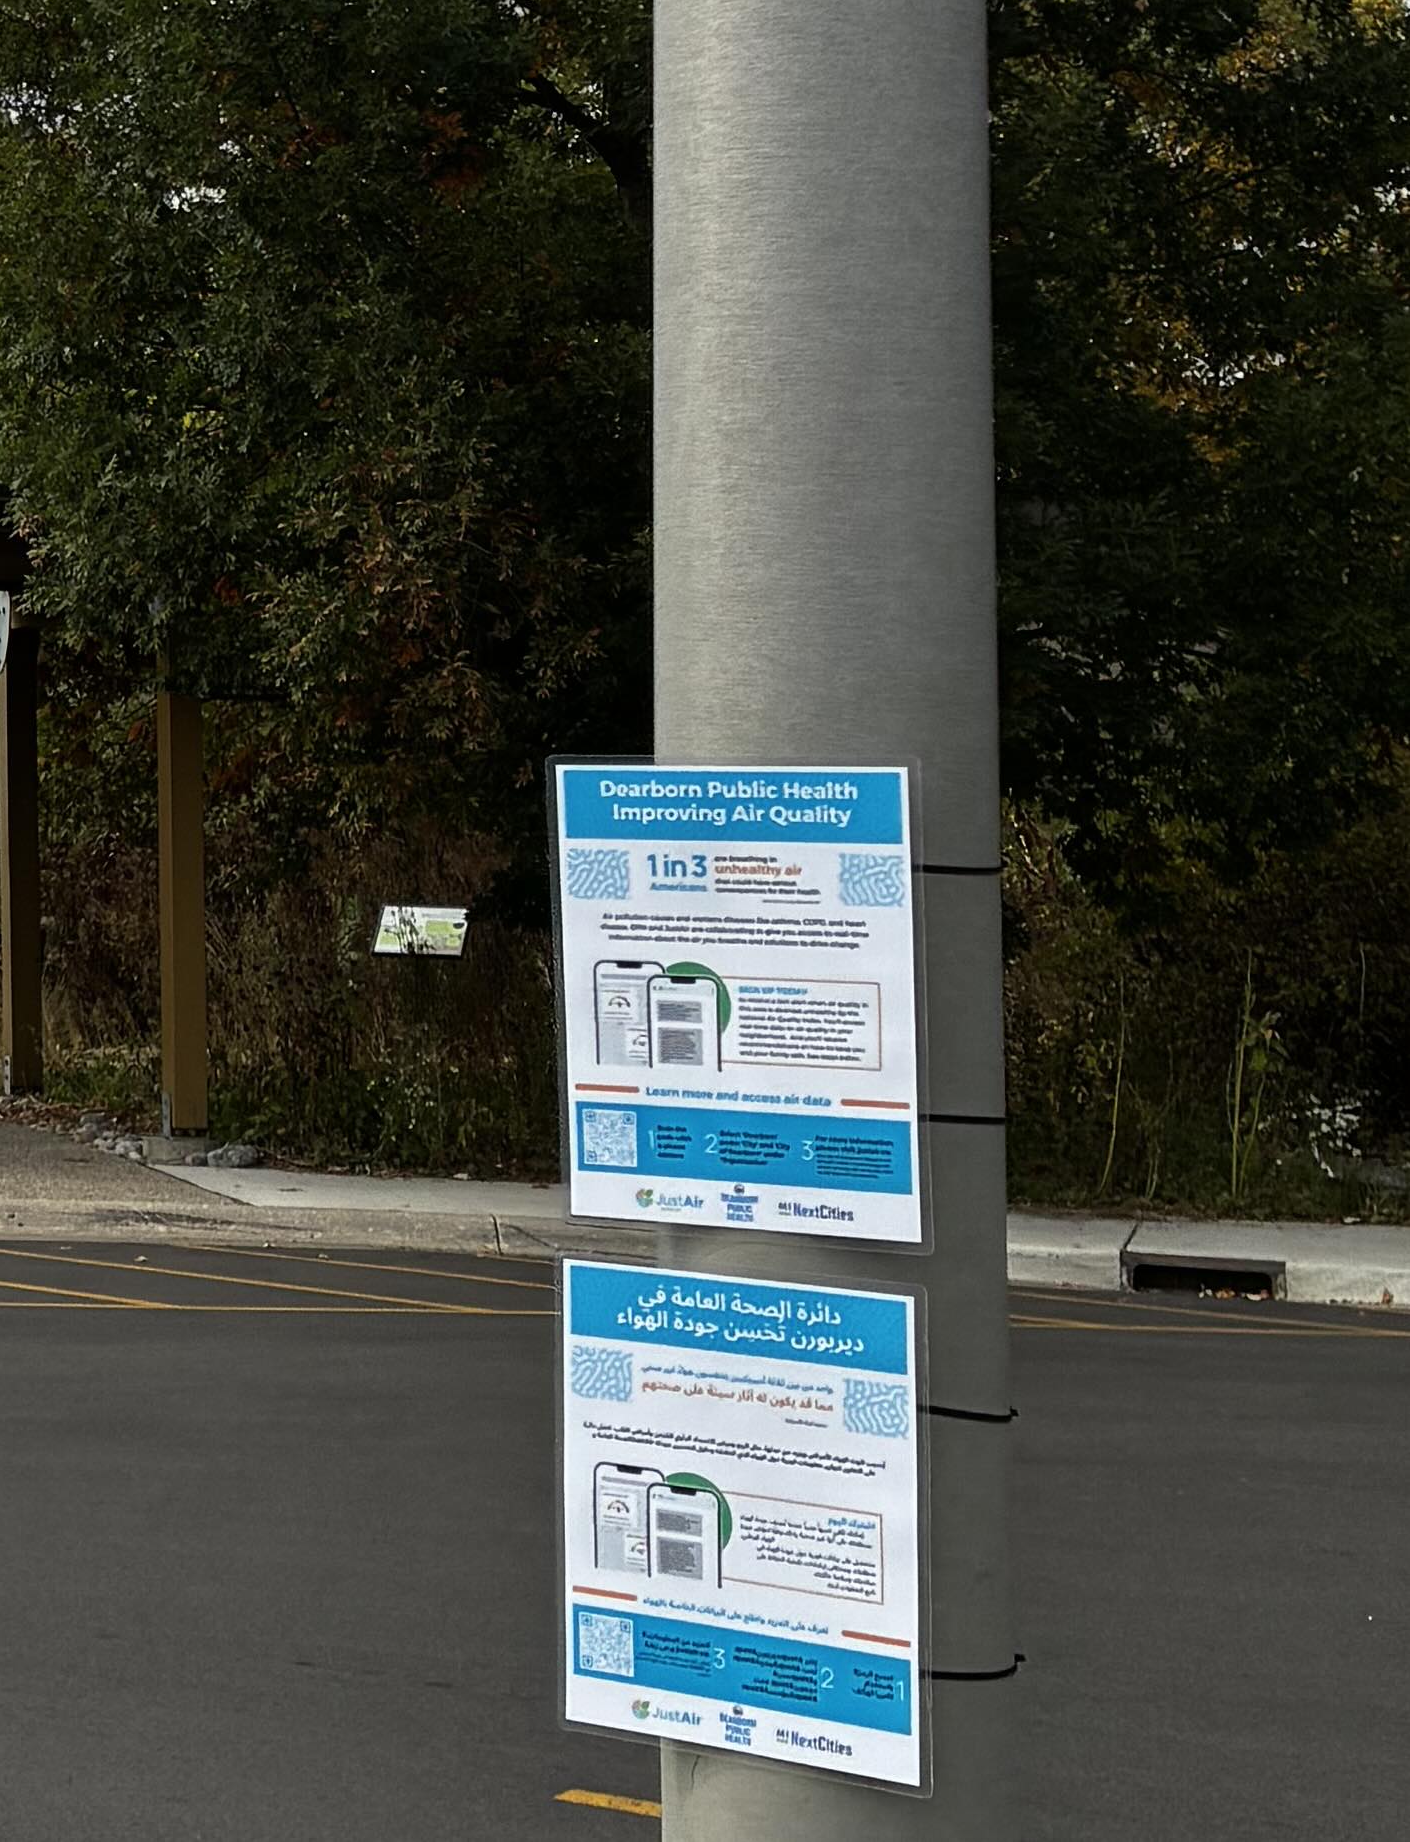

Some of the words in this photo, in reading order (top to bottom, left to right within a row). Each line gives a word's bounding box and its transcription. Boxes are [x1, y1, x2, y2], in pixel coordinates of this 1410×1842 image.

[599, 779, 703, 799] Dearborn
[707, 780, 779, 800] Public
[783, 781, 859, 801] Health
[613, 803, 727, 826] Improving
[731, 804, 766, 823] Air
[769, 804, 853, 828] Quality
[647, 853, 658, 877] 1
[663, 853, 687, 878] in
[691, 854, 708, 878] 3
[714, 864, 781, 879] unhealthy
[784, 865, 803, 877] air
[646, 1086, 680, 1098] Learn
[682, 1089, 714, 1100] more
[716, 1090, 739, 1102] and
[741, 1093, 782, 1104] access
[784, 1093, 800, 1105] air
[802, 1094, 832, 1107] data
[704, 1134, 719, 1154] 2
[801, 1140, 814, 1161] 3
[656, 1192, 704, 1209] JustAir
[793, 1202, 854, 1222] NextCities
[637, 1284, 666, 1312] في
[670, 1285, 726, 1312] العامة
[730, 1292, 792, 1324] الصحة
[616, 1306, 668, 1332] الهواء
[796, 1300, 841, 1326] دائرة
[673, 1310, 719, 1339] جودة
[790, 1330, 865, 1357] ديربورن
[713, 1648, 726, 1669] 3
[820, 1667, 834, 1689] 2
[894, 1680, 905, 1701] 1
[651, 1707, 702, 1726] JustAir
[790, 1731, 853, 1757] NextCities
